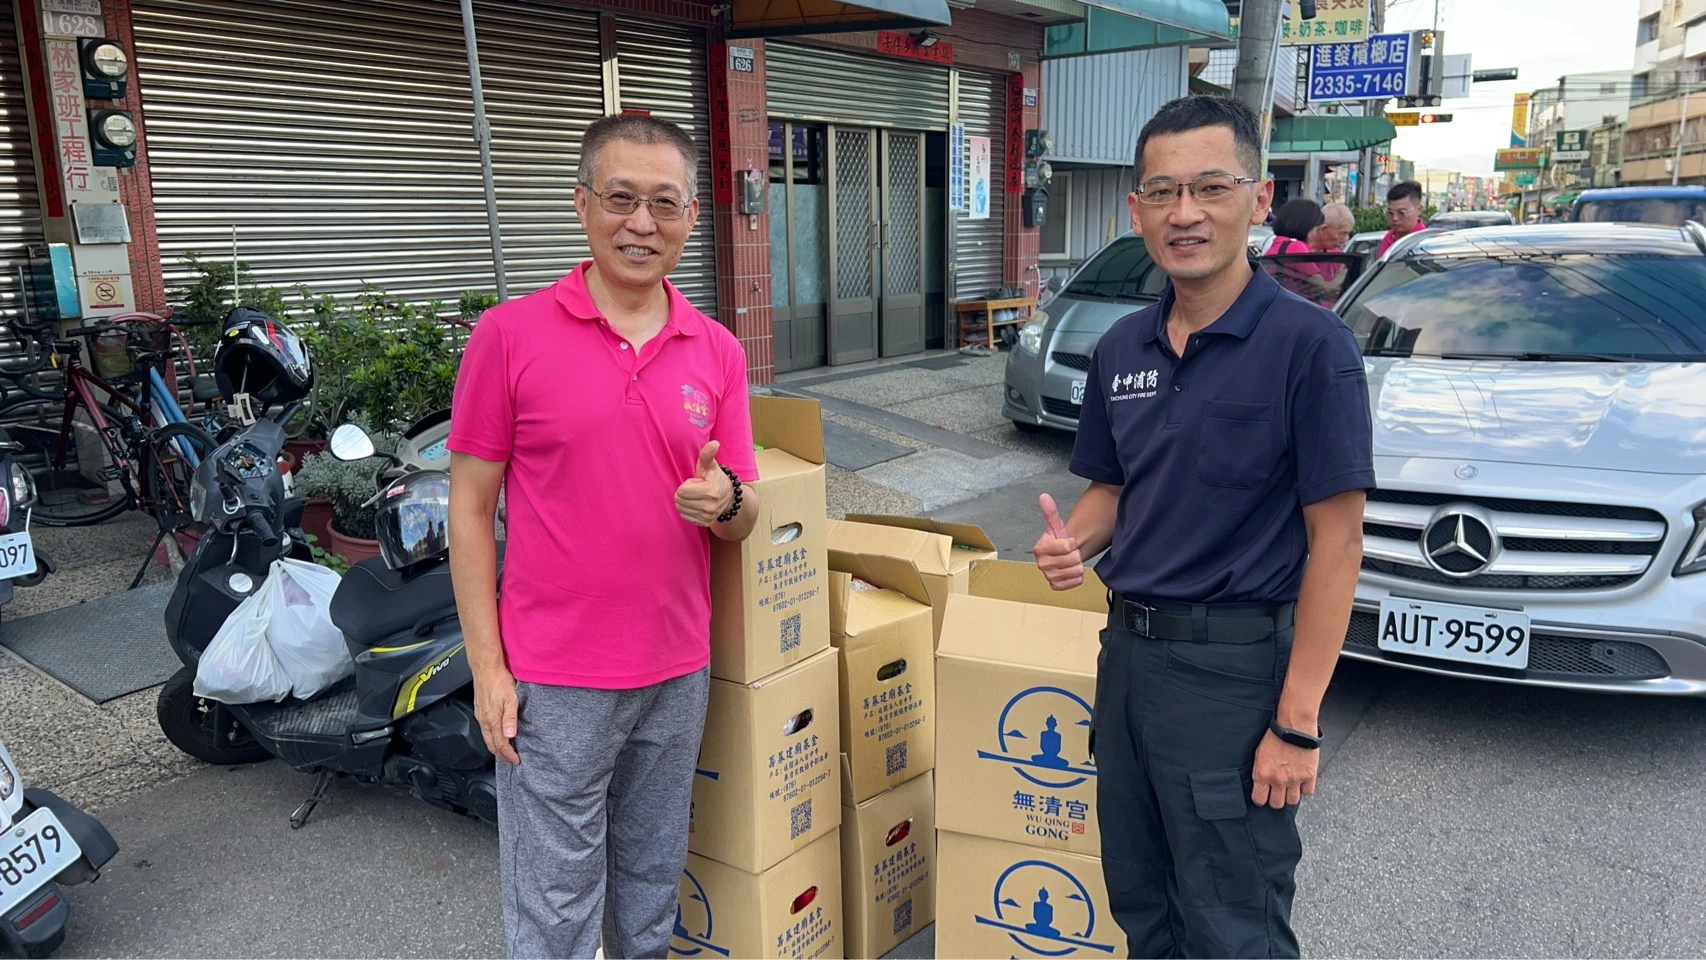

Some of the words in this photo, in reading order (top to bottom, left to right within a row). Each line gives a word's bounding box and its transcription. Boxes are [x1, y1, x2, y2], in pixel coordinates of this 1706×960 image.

[59, 14, 98, 36] 628
[1315, 38, 1407, 68] 進發檳榔店
[735, 58, 752, 72] 626
[1314, 72, 1403, 95] 2335-7146
[51, 40, 90, 190] 林家班工程行
[1110, 394, 1129, 402] TAICHUNG
[1012, 790, 1088, 821] 無清宮
[1026, 814, 1042, 824] WU
[1045, 817, 1070, 828] QING
[1025, 824, 1069, 841] GONG
